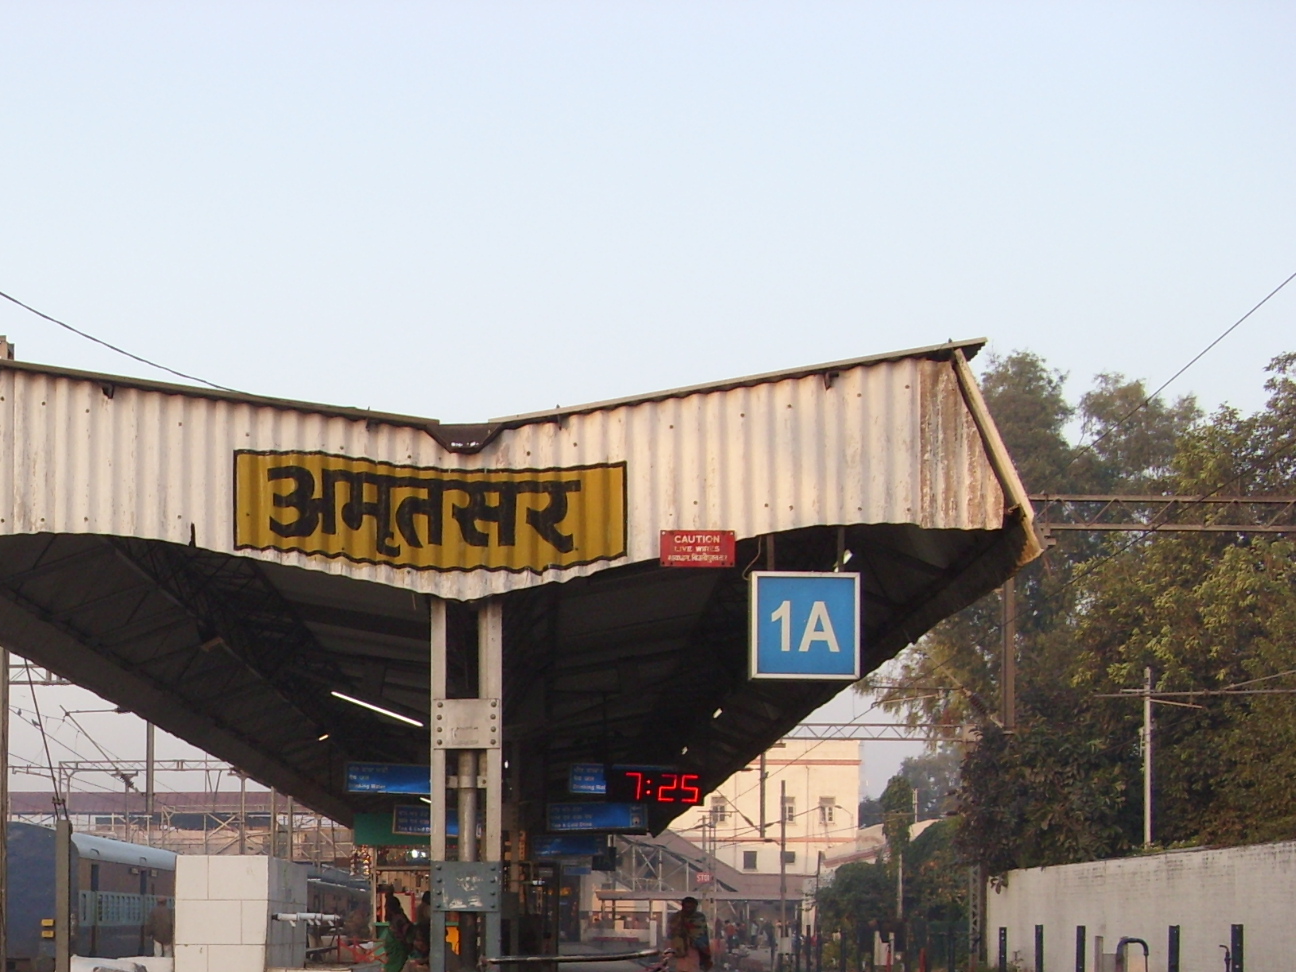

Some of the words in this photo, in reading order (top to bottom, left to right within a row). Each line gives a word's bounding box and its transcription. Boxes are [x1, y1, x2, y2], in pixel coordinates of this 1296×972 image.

[267, 466, 582, 558] अमृतसर
[674, 535, 720, 543] CAUTION
[771, 600, 840, 653] 1A
[625, 771, 700, 802] 7:25
